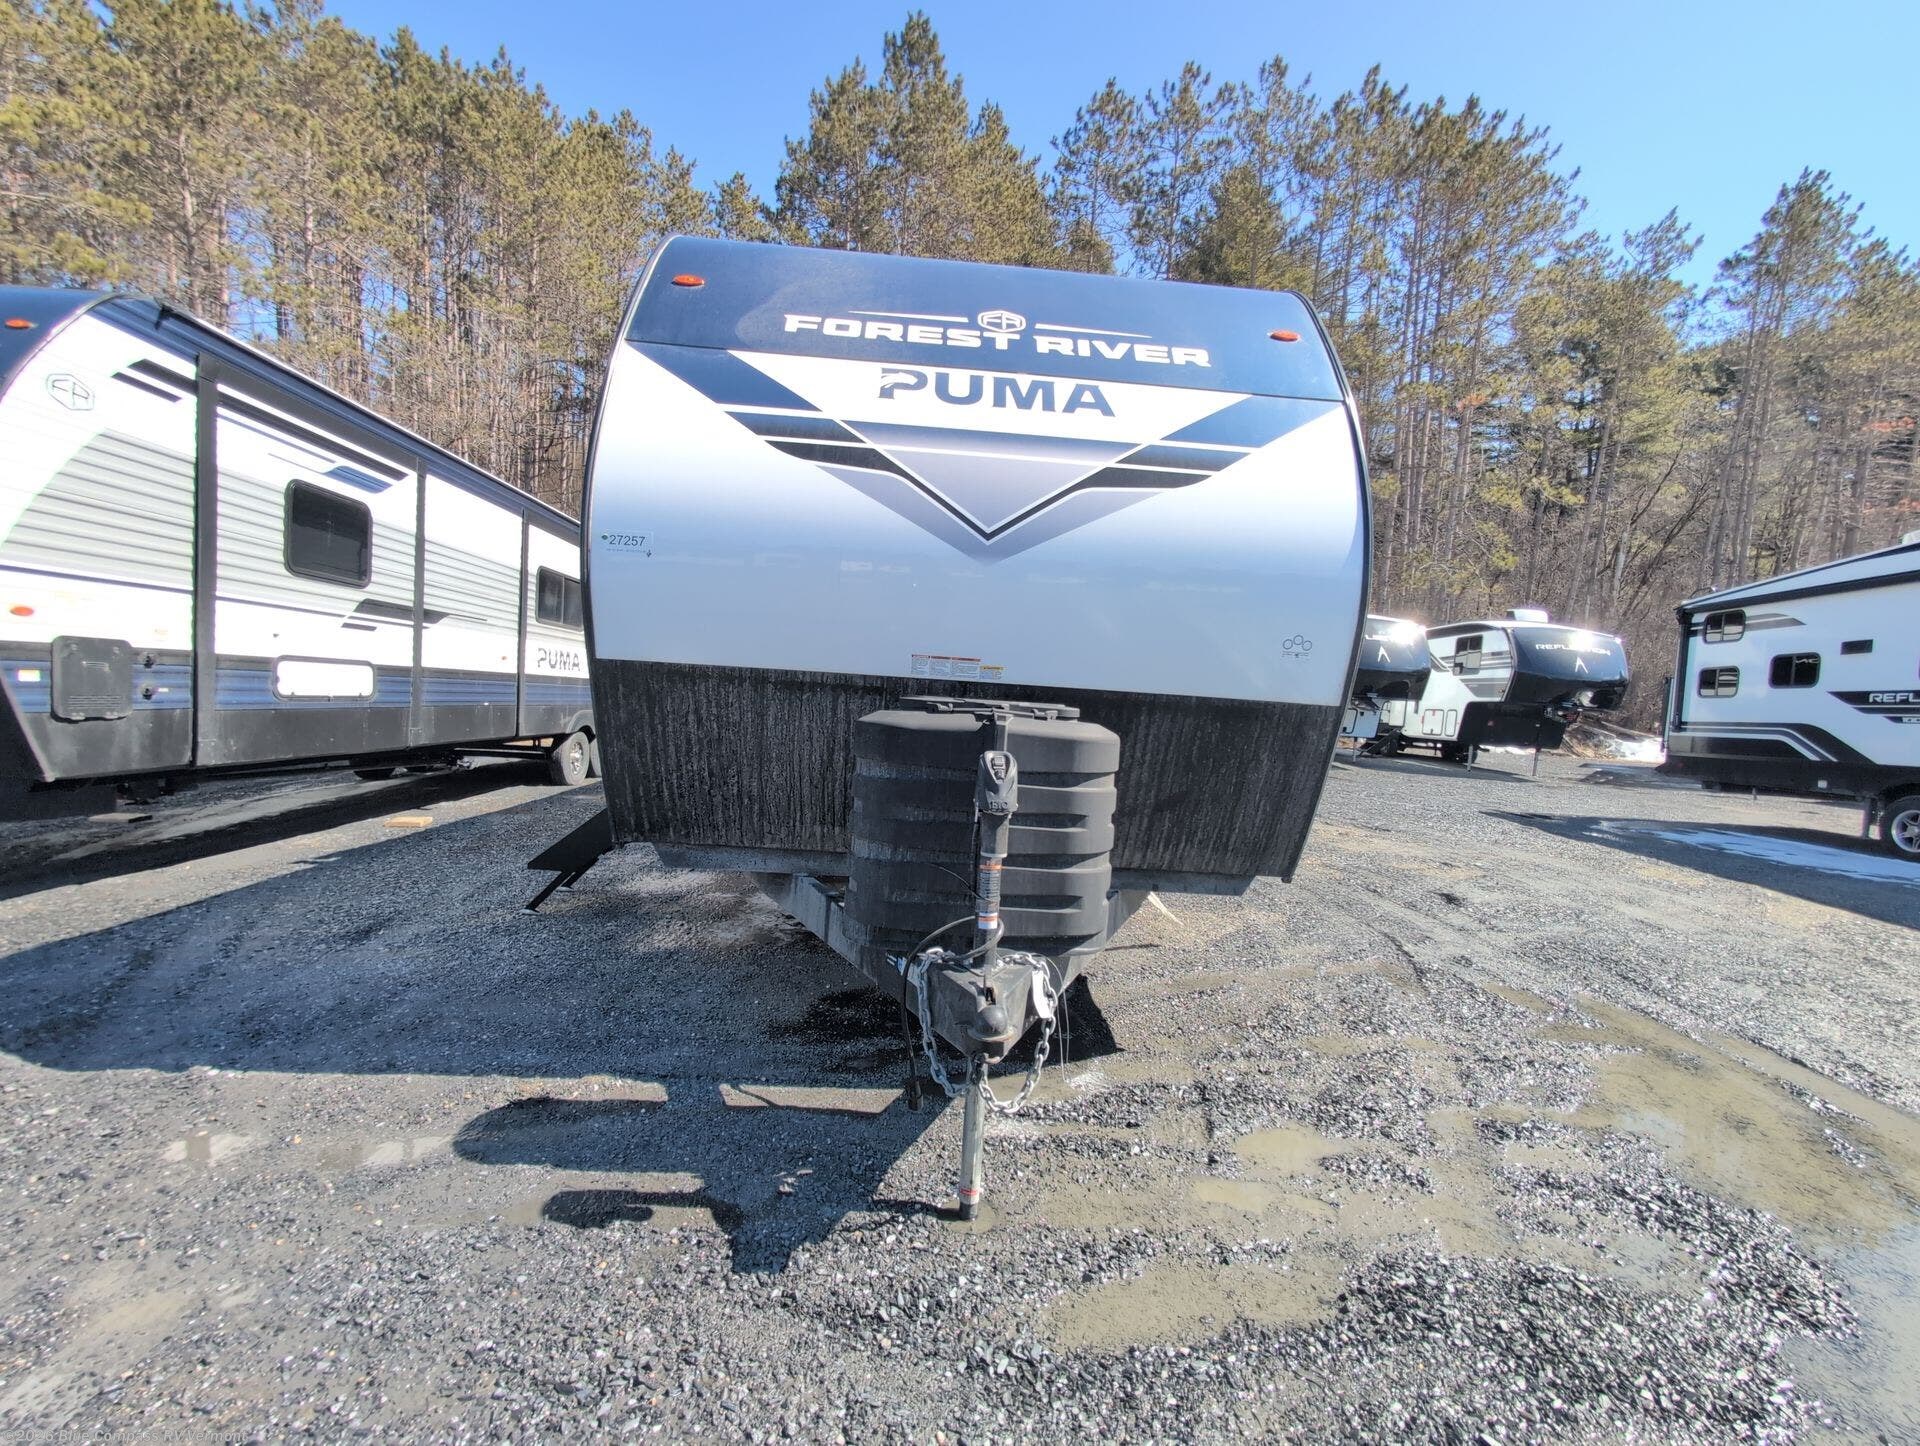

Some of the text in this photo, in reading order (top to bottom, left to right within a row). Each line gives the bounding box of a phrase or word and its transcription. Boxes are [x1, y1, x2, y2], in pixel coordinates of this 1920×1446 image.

[784, 314, 1212, 367] FOREST RIVER
[878, 367, 1116, 417] PUMA
[609, 534, 646, 547] 27257
[537, 647, 581, 672] PUMA
[1869, 692, 1920, 703] REFL
